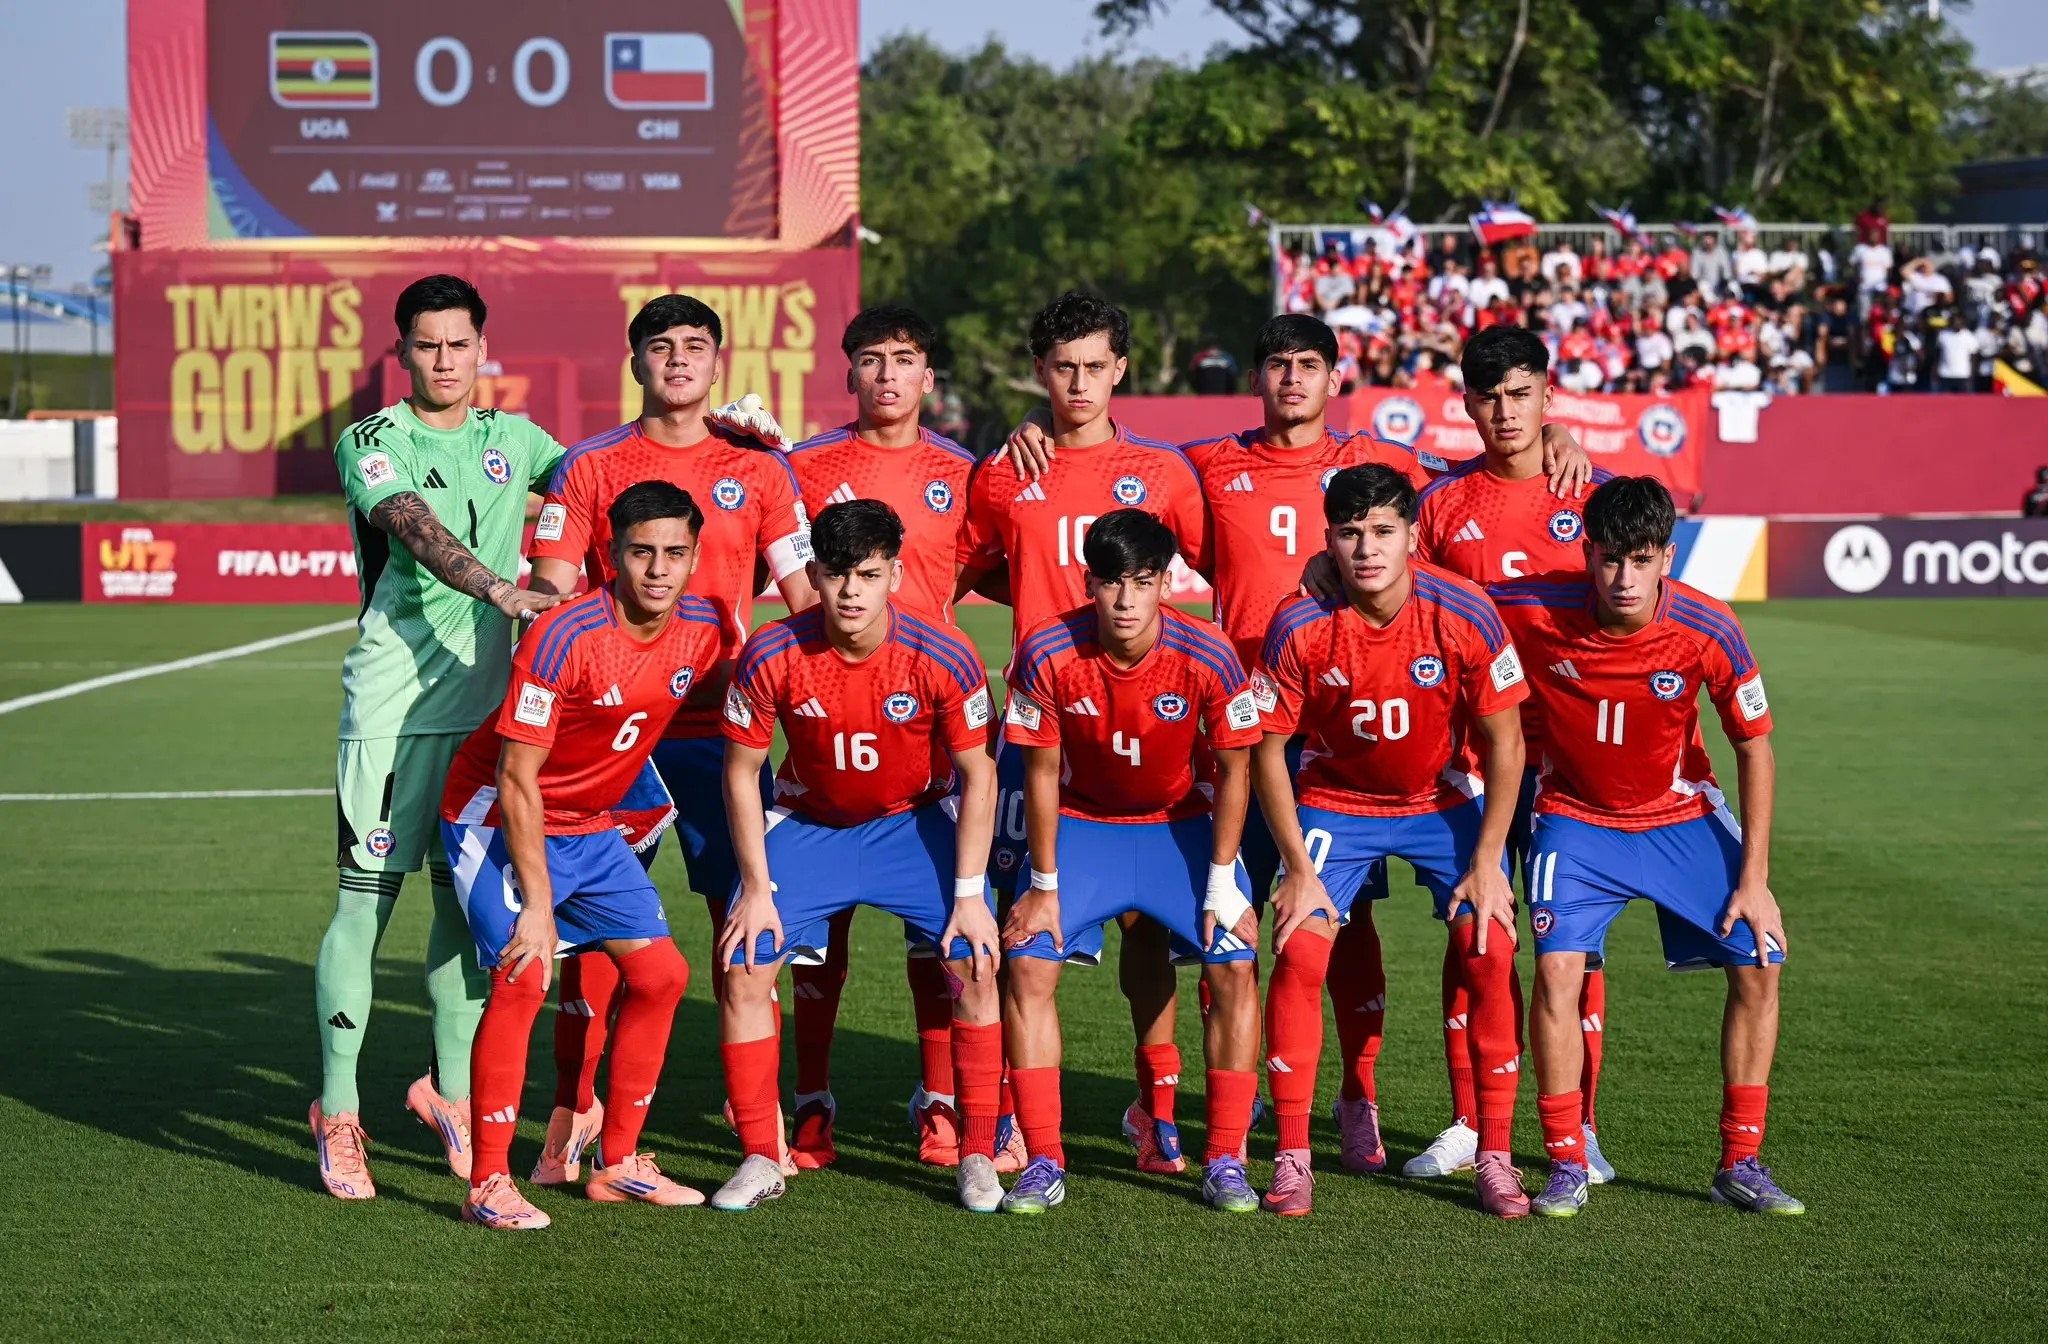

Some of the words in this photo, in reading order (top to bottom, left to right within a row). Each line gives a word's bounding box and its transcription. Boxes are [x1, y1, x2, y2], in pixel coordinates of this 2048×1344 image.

[415, 37, 472, 106] 0
[513, 37, 570, 107] 0
[300, 119, 349, 138] UGA
[638, 119, 680, 139] CHI
[467, 498, 479, 549] 1
[1269, 505, 1297, 555] 9
[217, 549, 279, 577] FIFA
[279, 549, 337, 577] U-17
[793, 541, 812, 552] UNI
[611, 711, 648, 752] 6
[1350, 697, 1410, 742] 20
[1596, 698, 1625, 745] 11
[833, 732, 879, 772] 16
[1112, 730, 1141, 766] 4
[1531, 851, 1557, 903] 11
